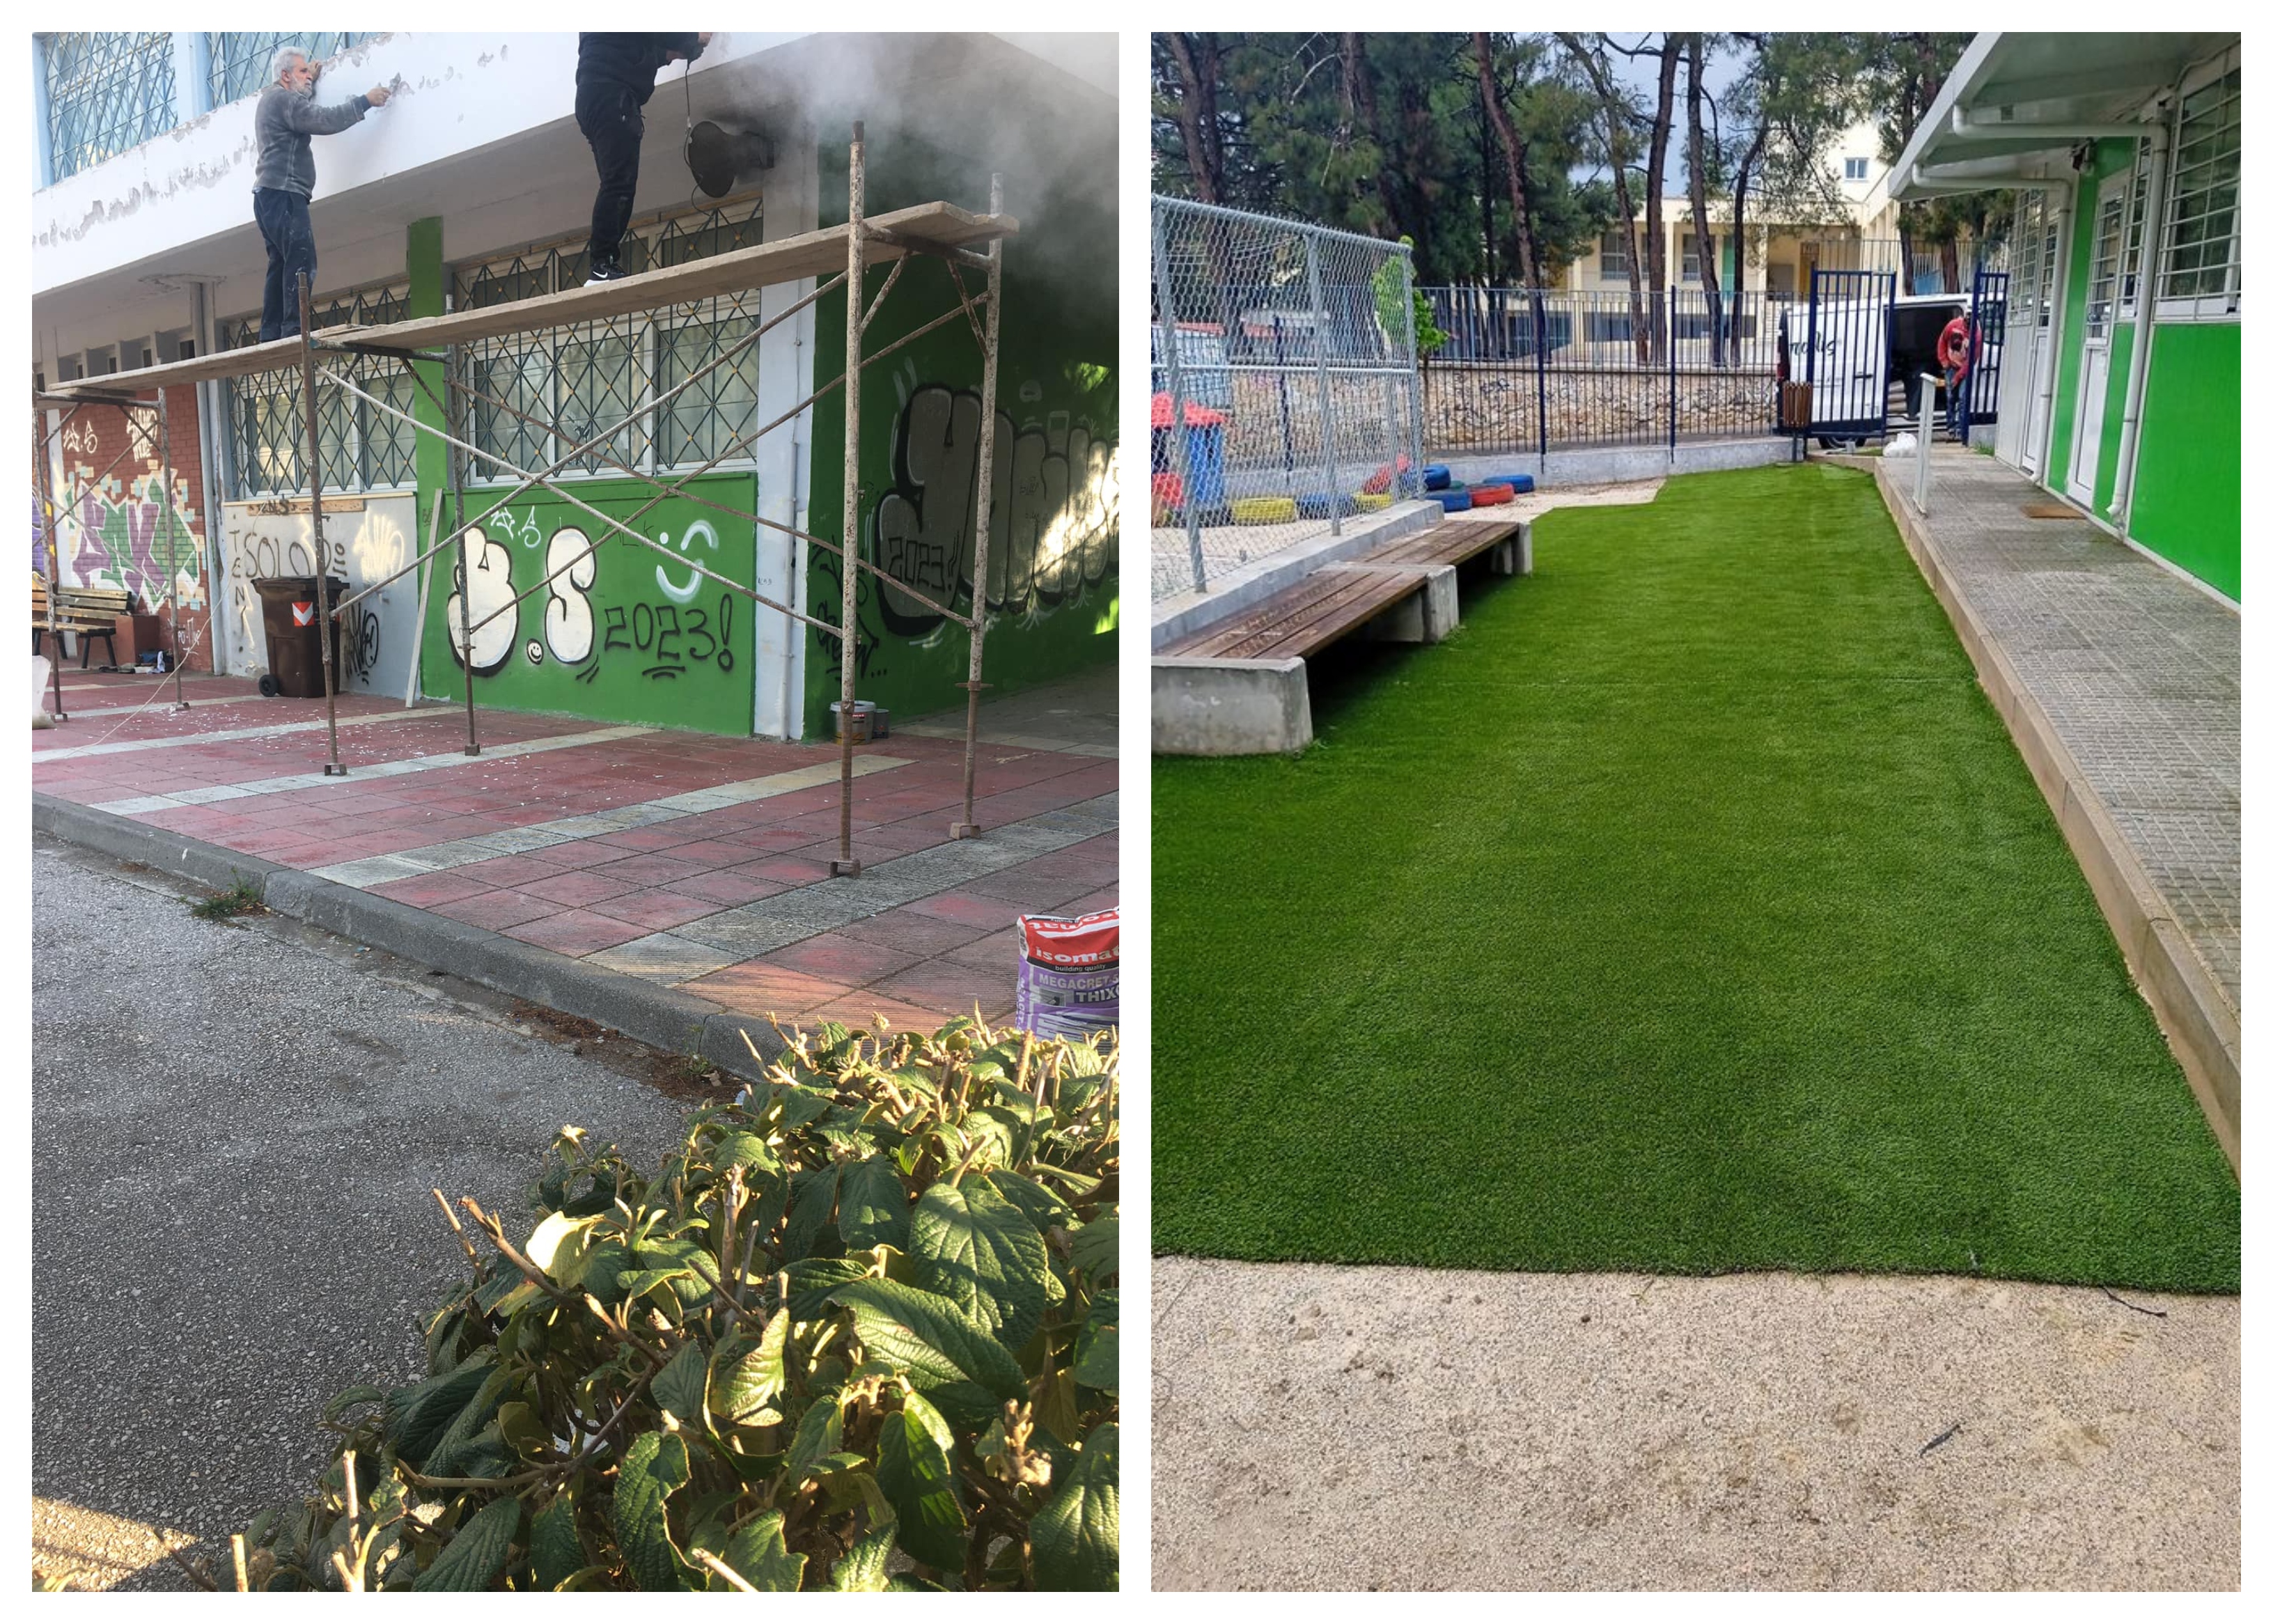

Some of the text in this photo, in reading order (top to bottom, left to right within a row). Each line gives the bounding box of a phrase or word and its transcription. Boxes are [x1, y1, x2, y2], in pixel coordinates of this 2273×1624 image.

[604, 593, 734, 672] 2023!
[1054, 963, 1106, 973] building quality
